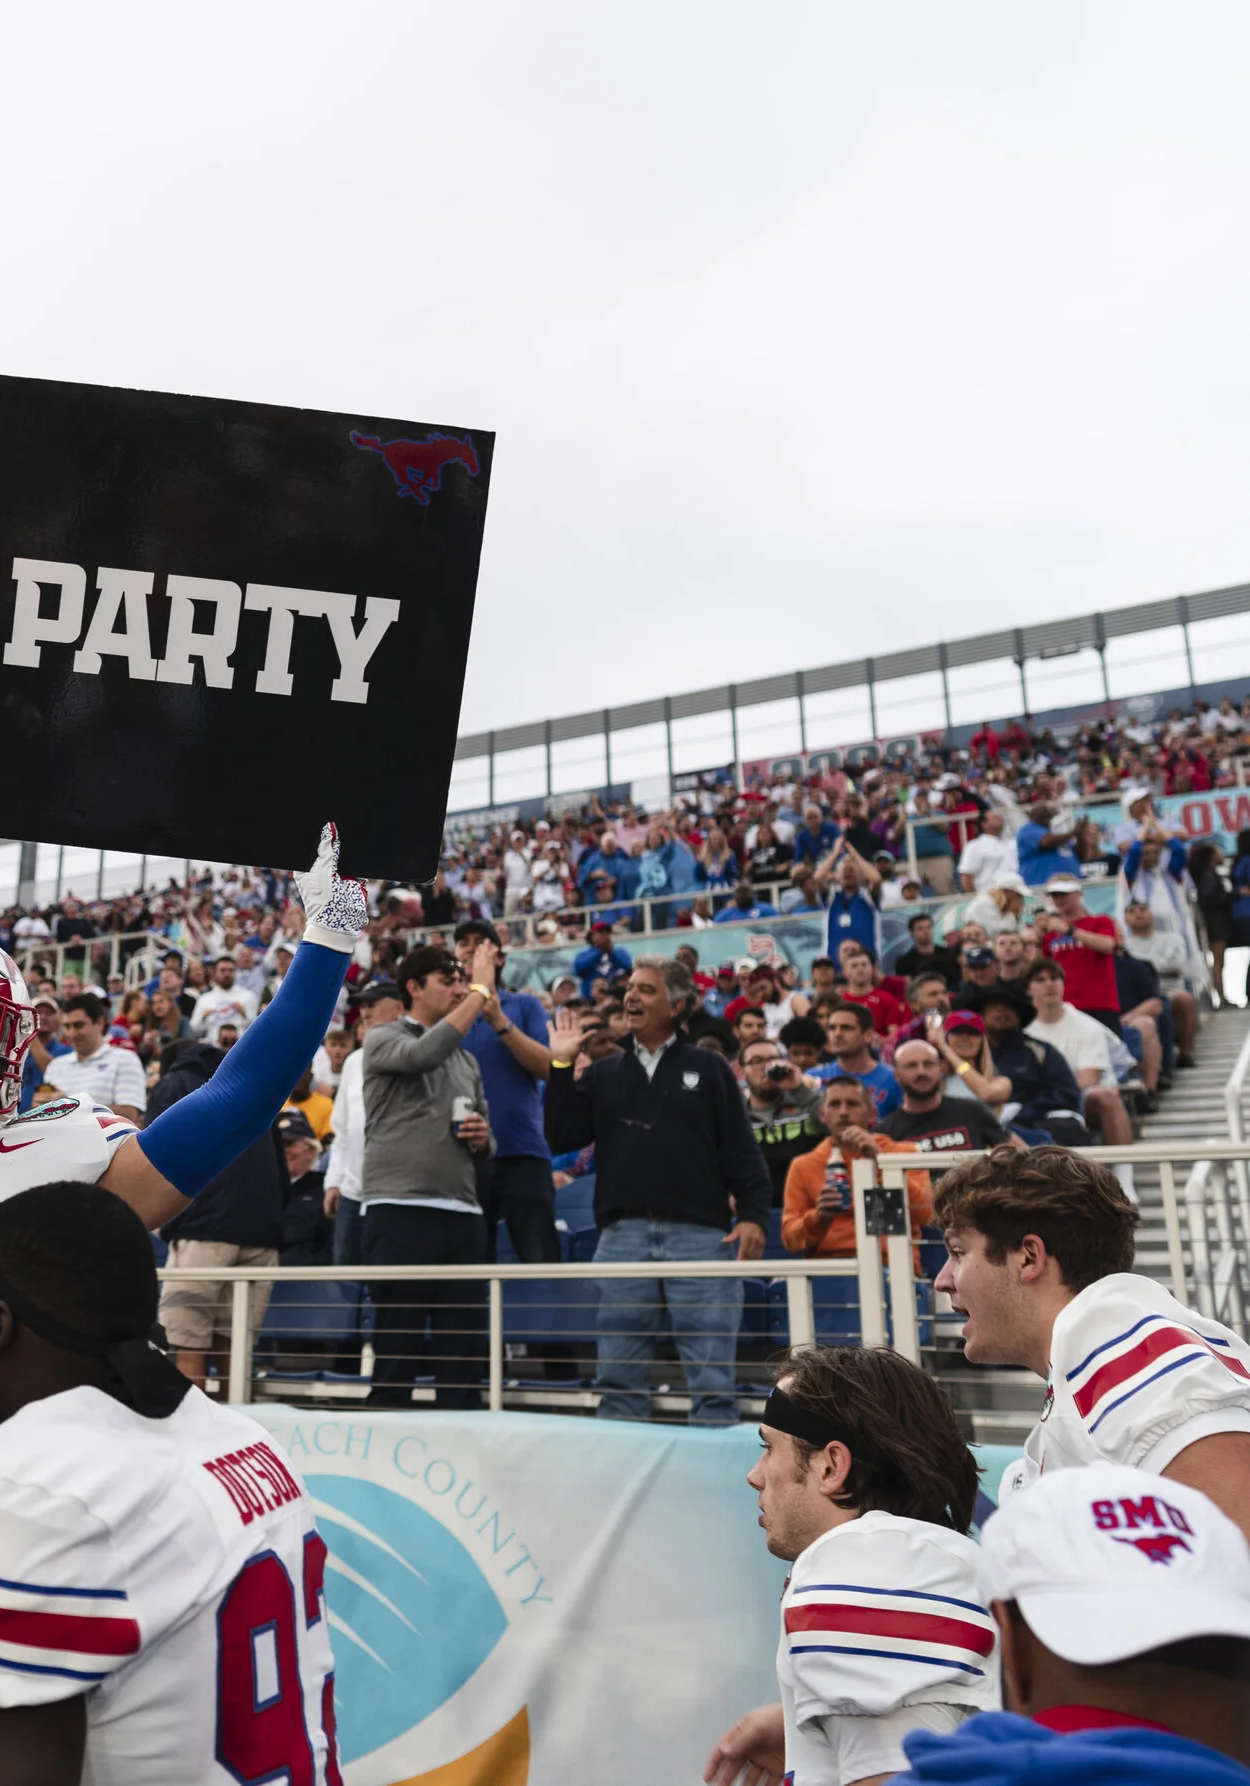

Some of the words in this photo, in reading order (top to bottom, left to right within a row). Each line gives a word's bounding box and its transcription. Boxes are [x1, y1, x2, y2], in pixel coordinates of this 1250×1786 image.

[2, 558, 401, 704] PARTY
[202, 1441, 302, 1526] DOTSON
[269, 1421, 374, 1460] ACH
[393, 1435, 554, 1608] COUNTY
[1091, 1496, 1196, 1537] SMU
